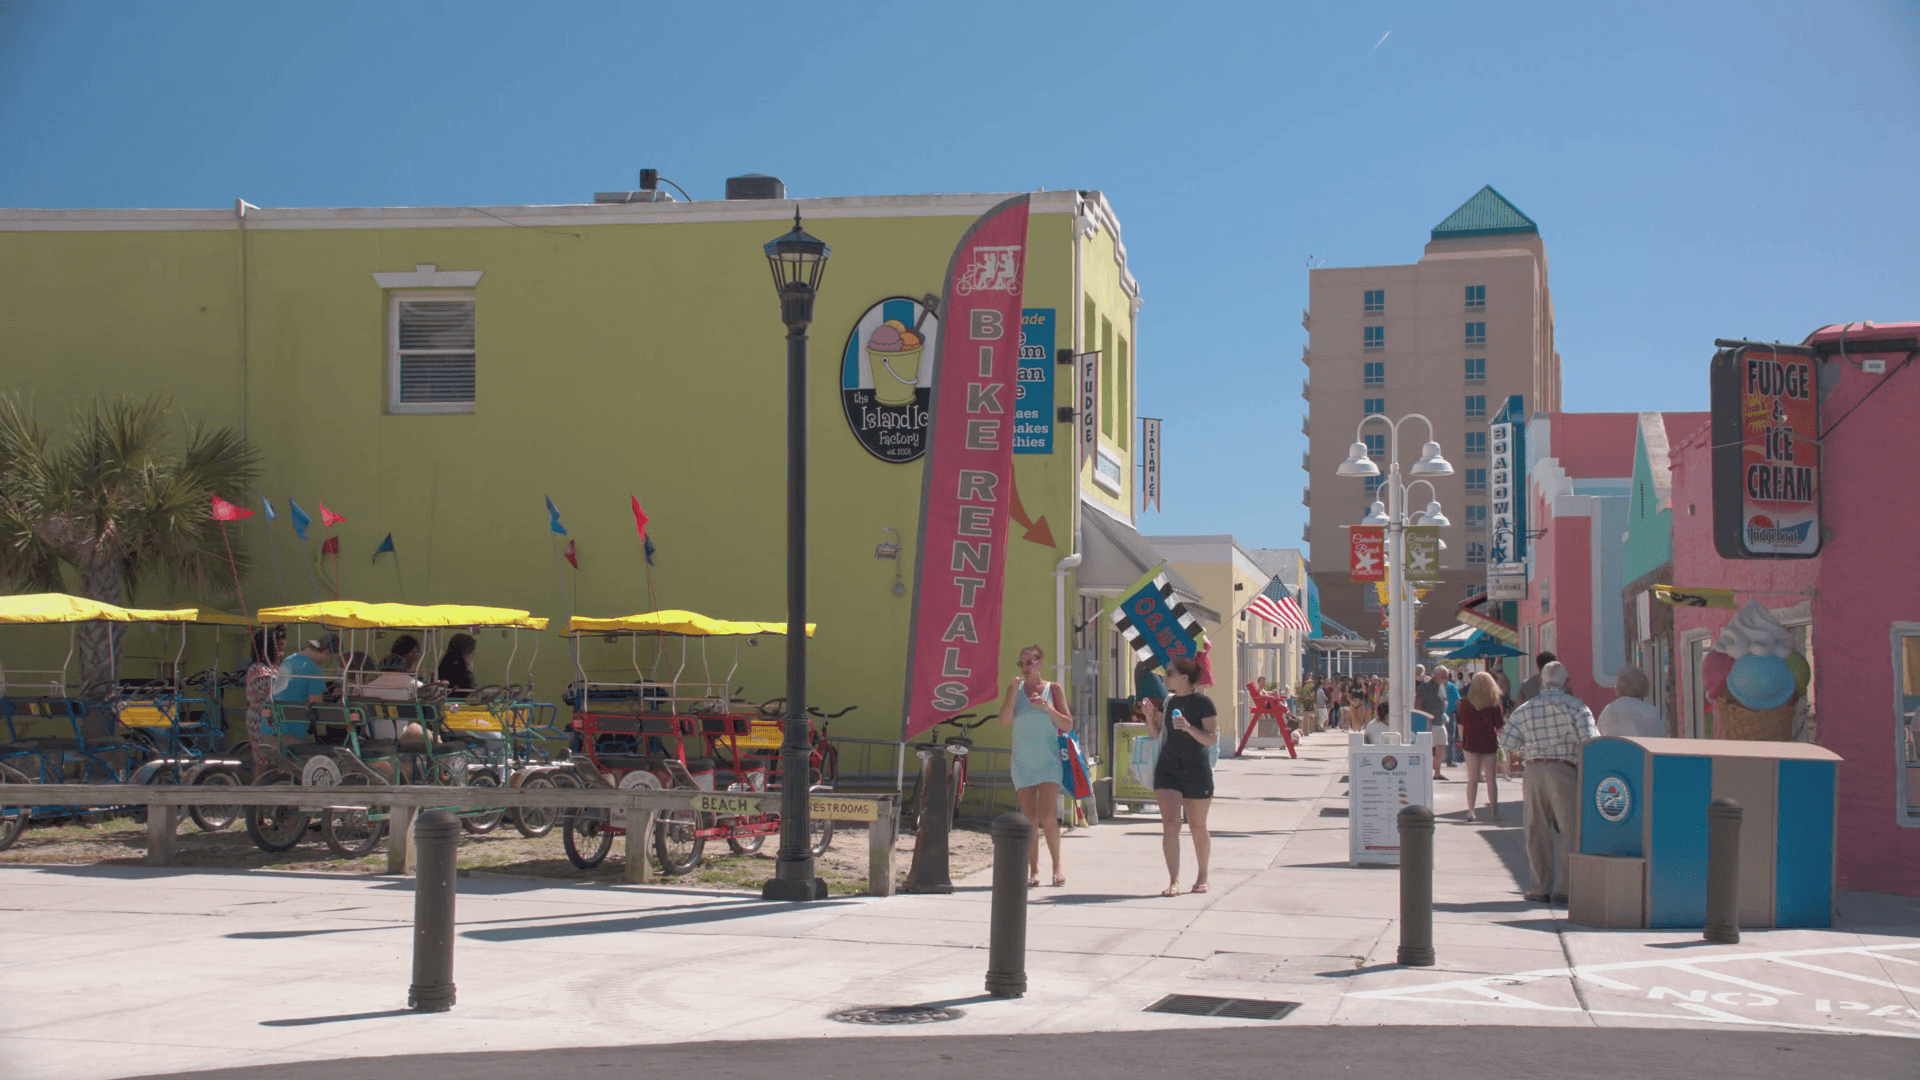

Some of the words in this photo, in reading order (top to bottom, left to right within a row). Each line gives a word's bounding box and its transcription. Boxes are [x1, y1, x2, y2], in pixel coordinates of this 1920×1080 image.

[854, 391, 869, 404] the
[965, 308, 1005, 450] BIKE
[1747, 359, 1809, 400] FUDGE
[861, 404, 911, 430] Island
[1084, 362, 1093, 443] FUDGE
[879, 430, 920, 447] Factory
[1765, 425, 1795, 462] ICE
[1493, 426, 1508, 560] BOARDWALK
[1747, 464, 1814, 502] CREAM
[931, 469, 999, 712] RENTALS
[1136, 597, 1188, 660] OPEN
[701, 796, 748, 811] BEACH
[1647, 986, 1779, 1007] NO
